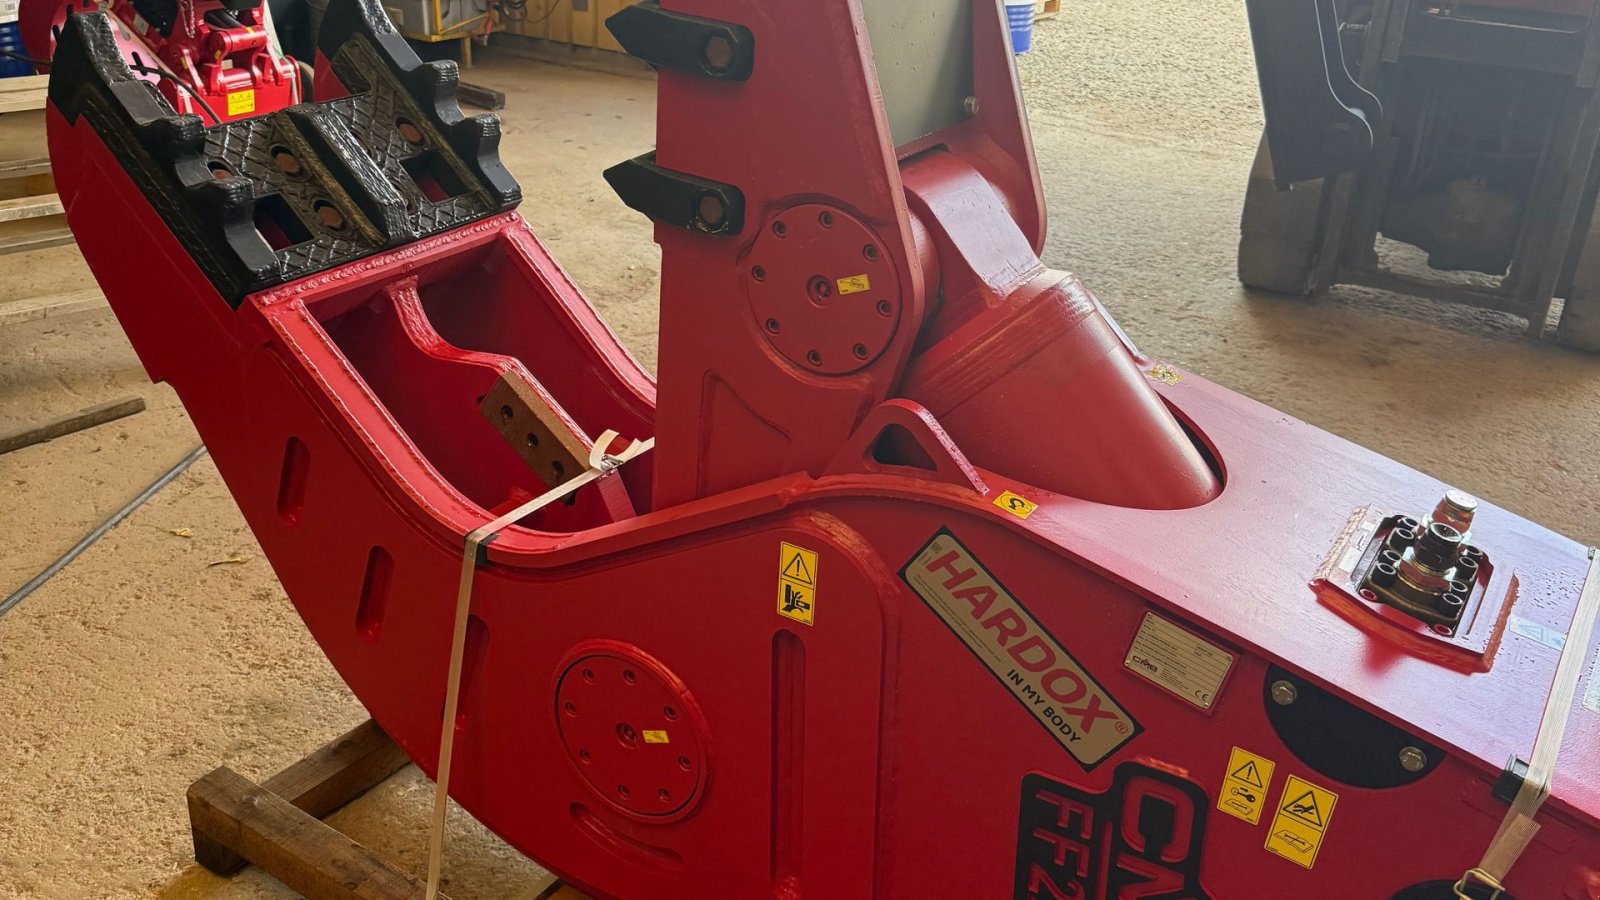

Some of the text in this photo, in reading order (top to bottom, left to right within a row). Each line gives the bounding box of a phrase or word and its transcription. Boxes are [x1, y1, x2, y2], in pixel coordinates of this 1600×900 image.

[1133, 656, 1158, 673] CMB
[1007, 669, 1081, 743] IN MY BODY
